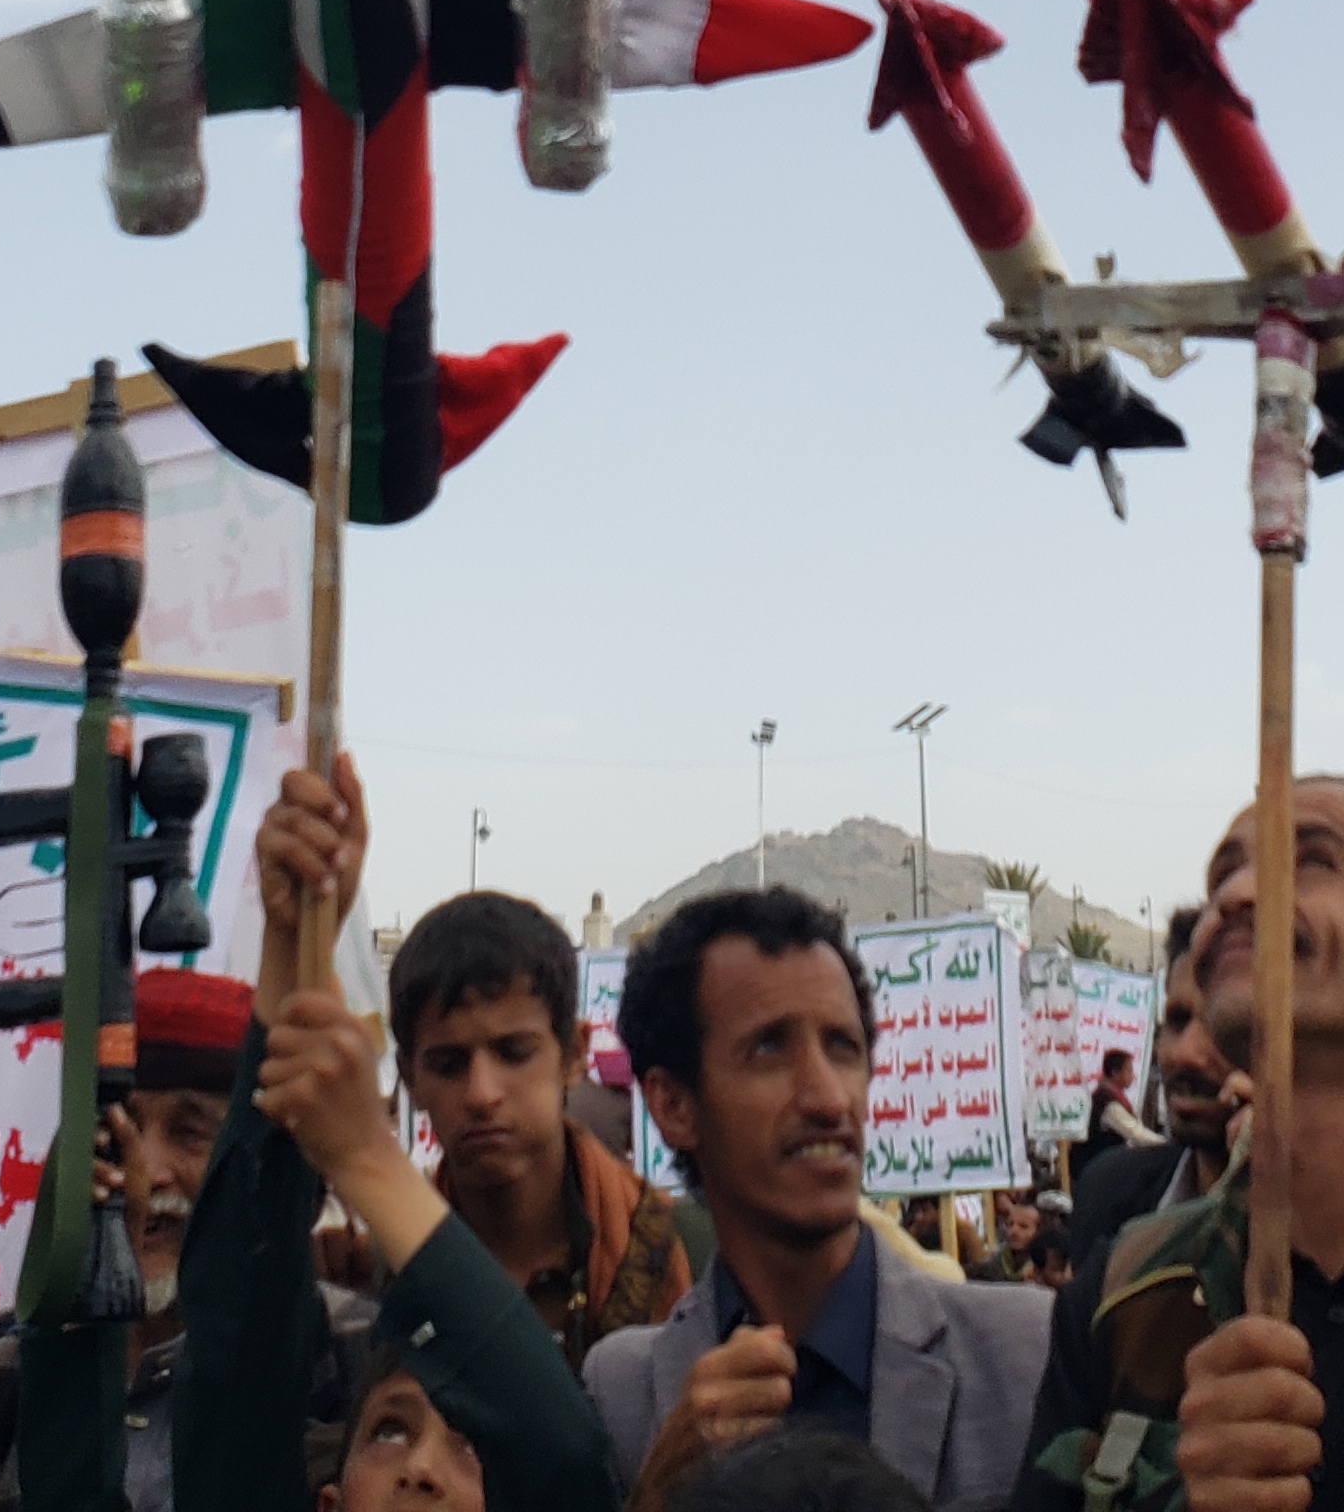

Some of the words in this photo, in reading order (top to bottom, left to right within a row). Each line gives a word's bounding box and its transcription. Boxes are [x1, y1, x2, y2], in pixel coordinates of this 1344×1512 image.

[873, 933, 940, 1000] أكبر
[945, 940, 994, 979] الله
[875, 995, 931, 1036] لأمريك
[939, 997, 994, 1032] الموت
[941, 1043, 995, 1079] الموت
[922, 1091, 947, 1127] على
[956, 1089, 998, 1119] اللعنة
[865, 1136, 935, 1185] للإسلام
[945, 1128, 1002, 1180] النصر
